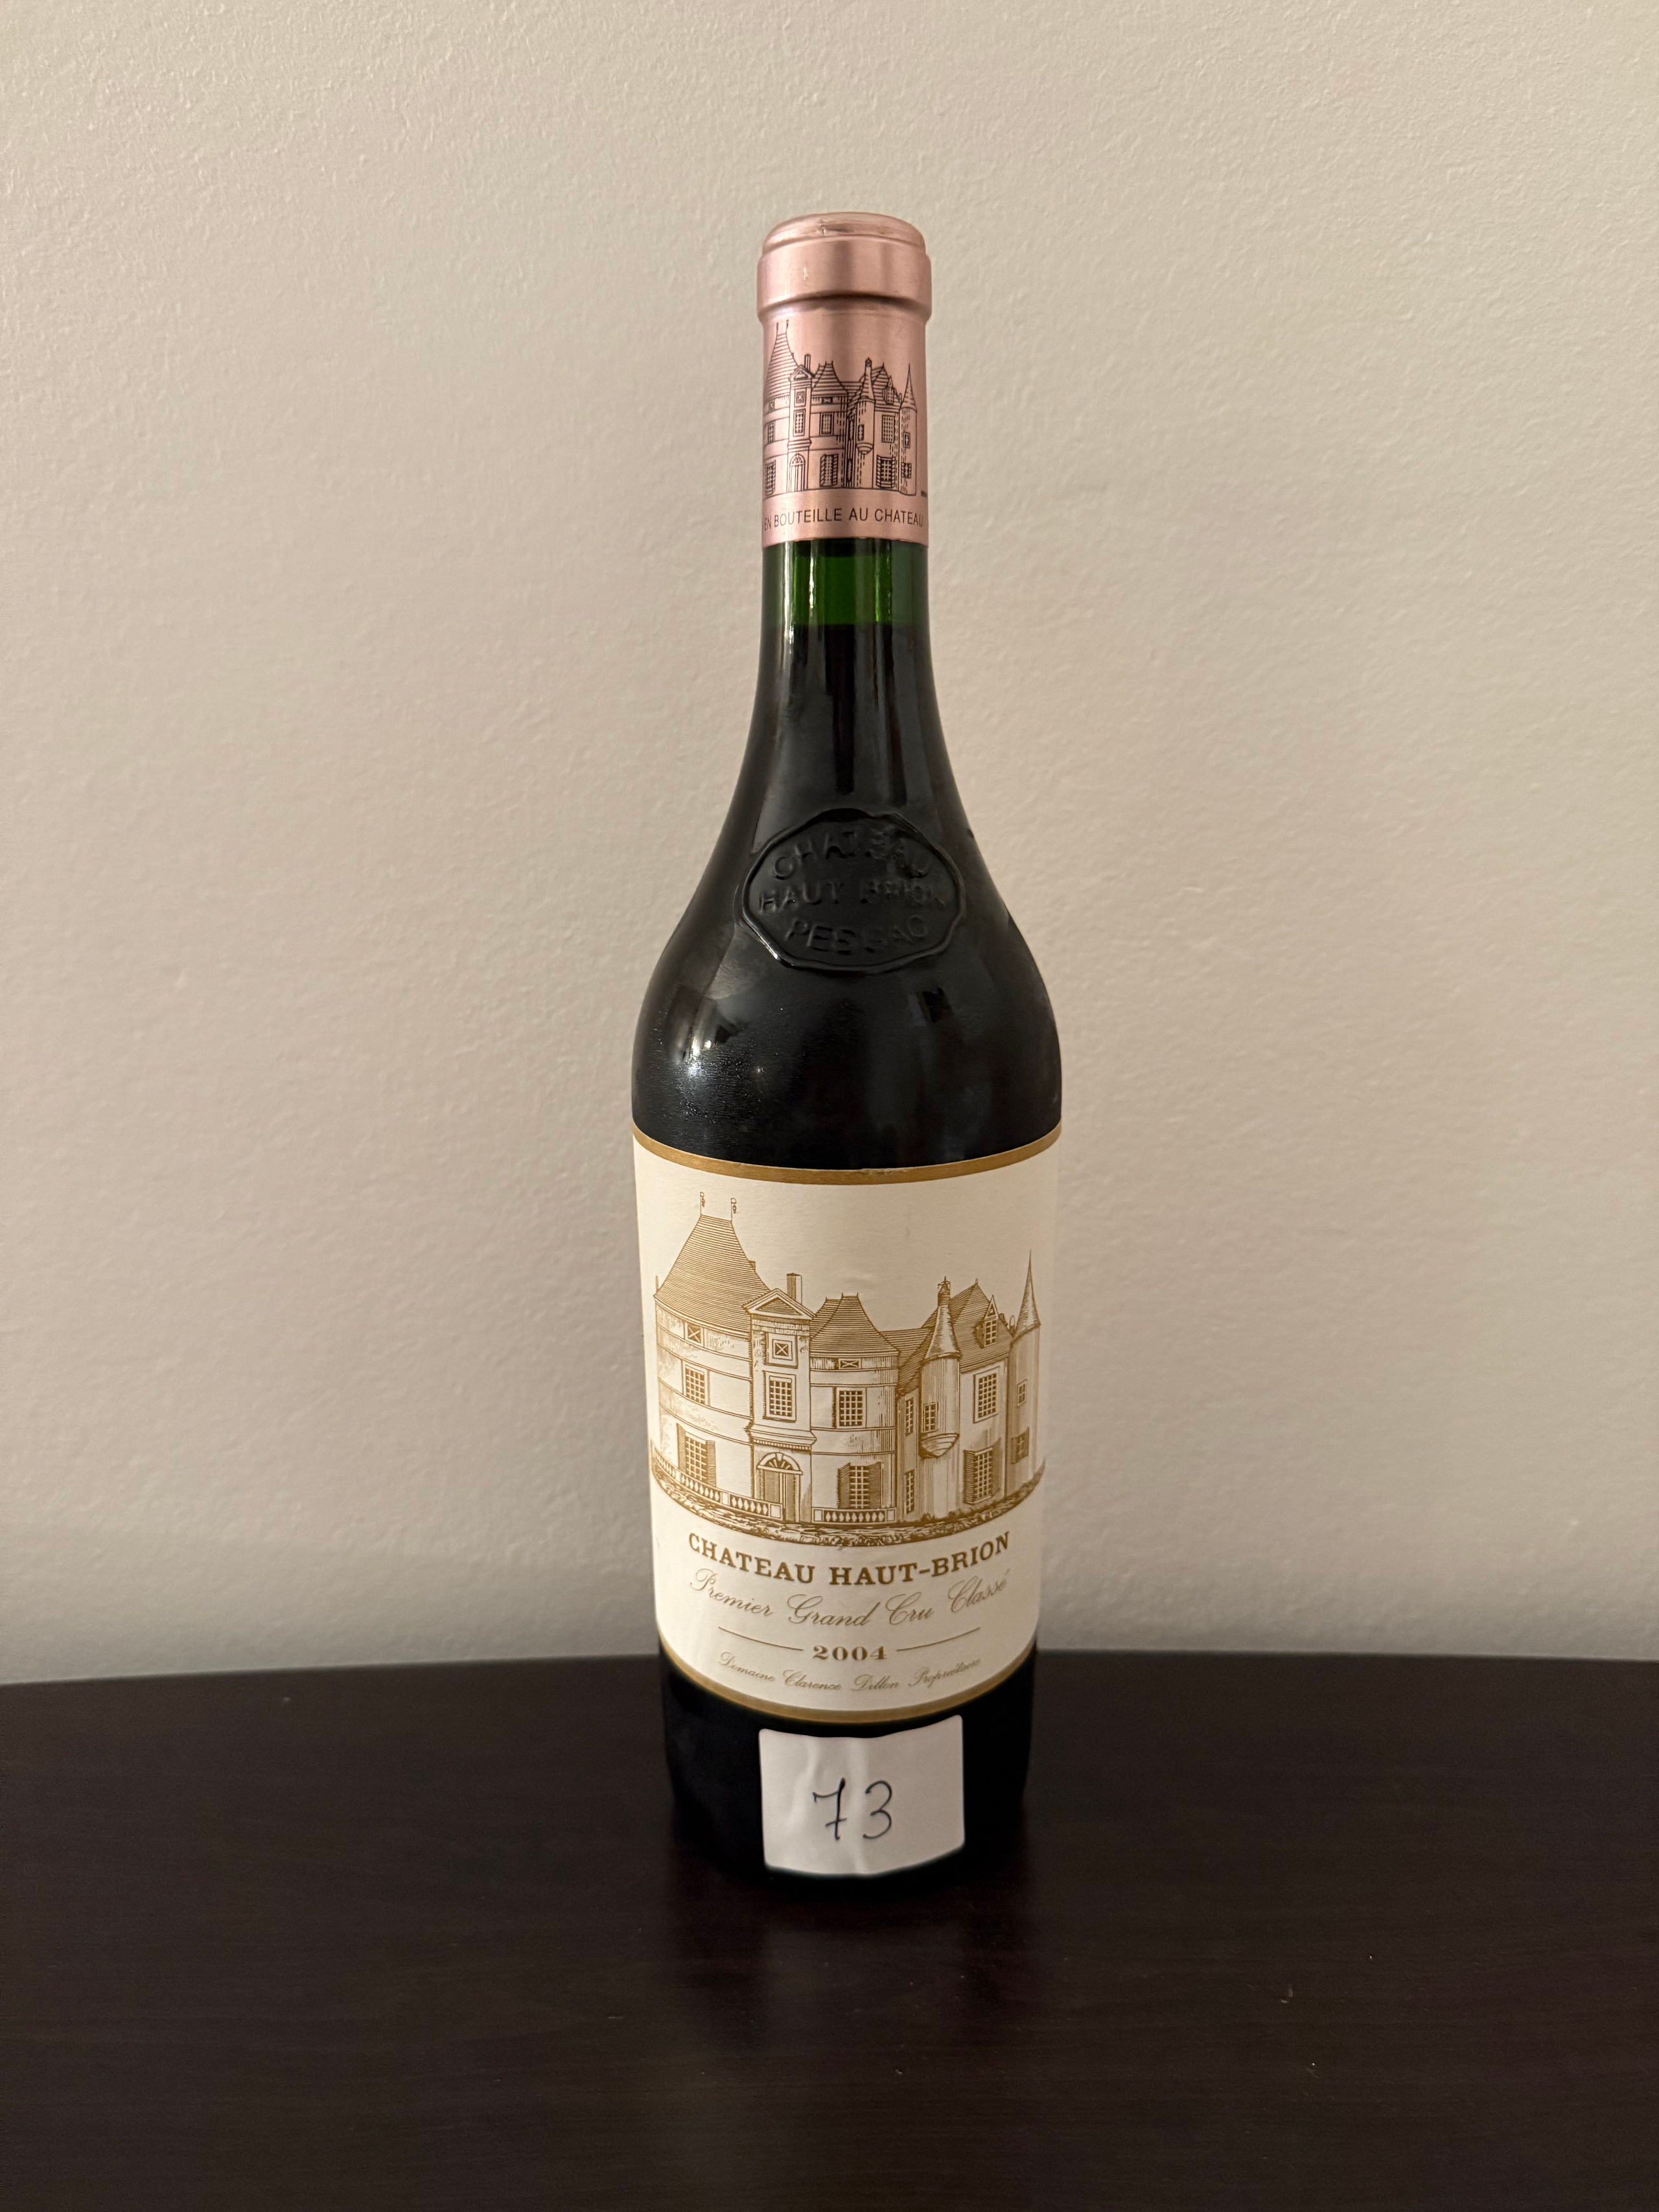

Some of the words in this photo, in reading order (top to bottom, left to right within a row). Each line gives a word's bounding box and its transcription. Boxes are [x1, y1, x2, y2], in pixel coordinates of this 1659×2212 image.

[774, 508, 842, 528] BOUTEILLE
[849, 507, 868, 522] AU
[874, 508, 924, 527] CHATEAU
[689, 1532, 815, 1584] CHATEAU
[829, 1531, 1010, 1585] HAUT-BRION
[690, 1568, 773, 1617] Premier
[787, 1594, 881, 1626] Grand
[885, 1592, 933, 1625] Cru
[947, 1568, 1010, 1613] Classé
[719, 1651, 776, 1682] Domaine
[783, 1670, 841, 1690] Clarence
[850, 1673, 899, 1691] Dillon
[813, 1645, 887, 1661] 2004
[812, 1777, 892, 1841] 73
